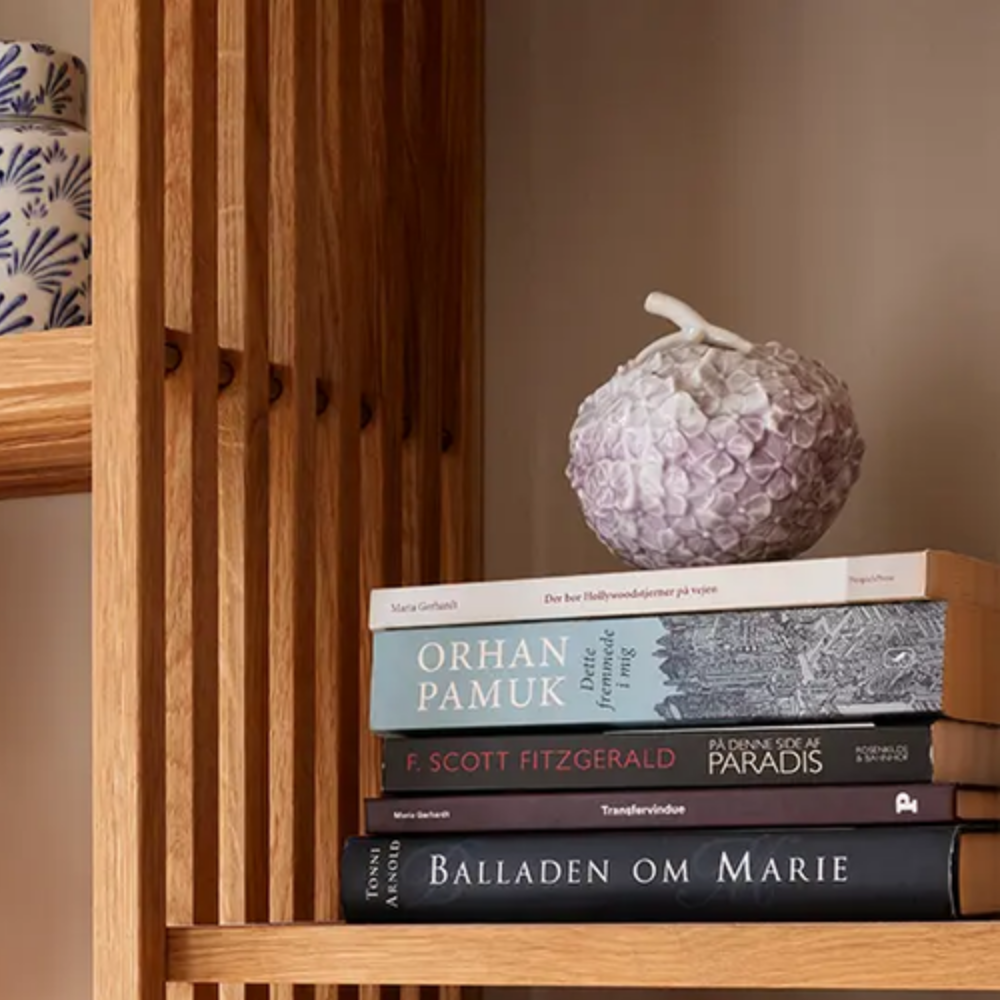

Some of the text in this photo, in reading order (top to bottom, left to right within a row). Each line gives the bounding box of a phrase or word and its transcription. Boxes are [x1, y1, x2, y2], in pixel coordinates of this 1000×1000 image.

[676, 585, 689, 598] på
[417, 636, 569, 672] ORHAN
[580, 647, 596, 691] Dette
[595, 629, 616, 712] fremmede
[620, 647, 636, 678] mig
[417, 676, 568, 712] PAMUK
[406, 747, 676, 772] F. SCOTT FITZGERALD
[776, 737, 803, 750] SIDE
[709, 750, 823, 775] PARADIS
[601, 803, 686, 818] Transfervindue
[365, 847, 380, 900] TONNI
[386, 840, 400, 908] ARNOLD
[429, 850, 849, 886] BALLADEN OM MARIE
